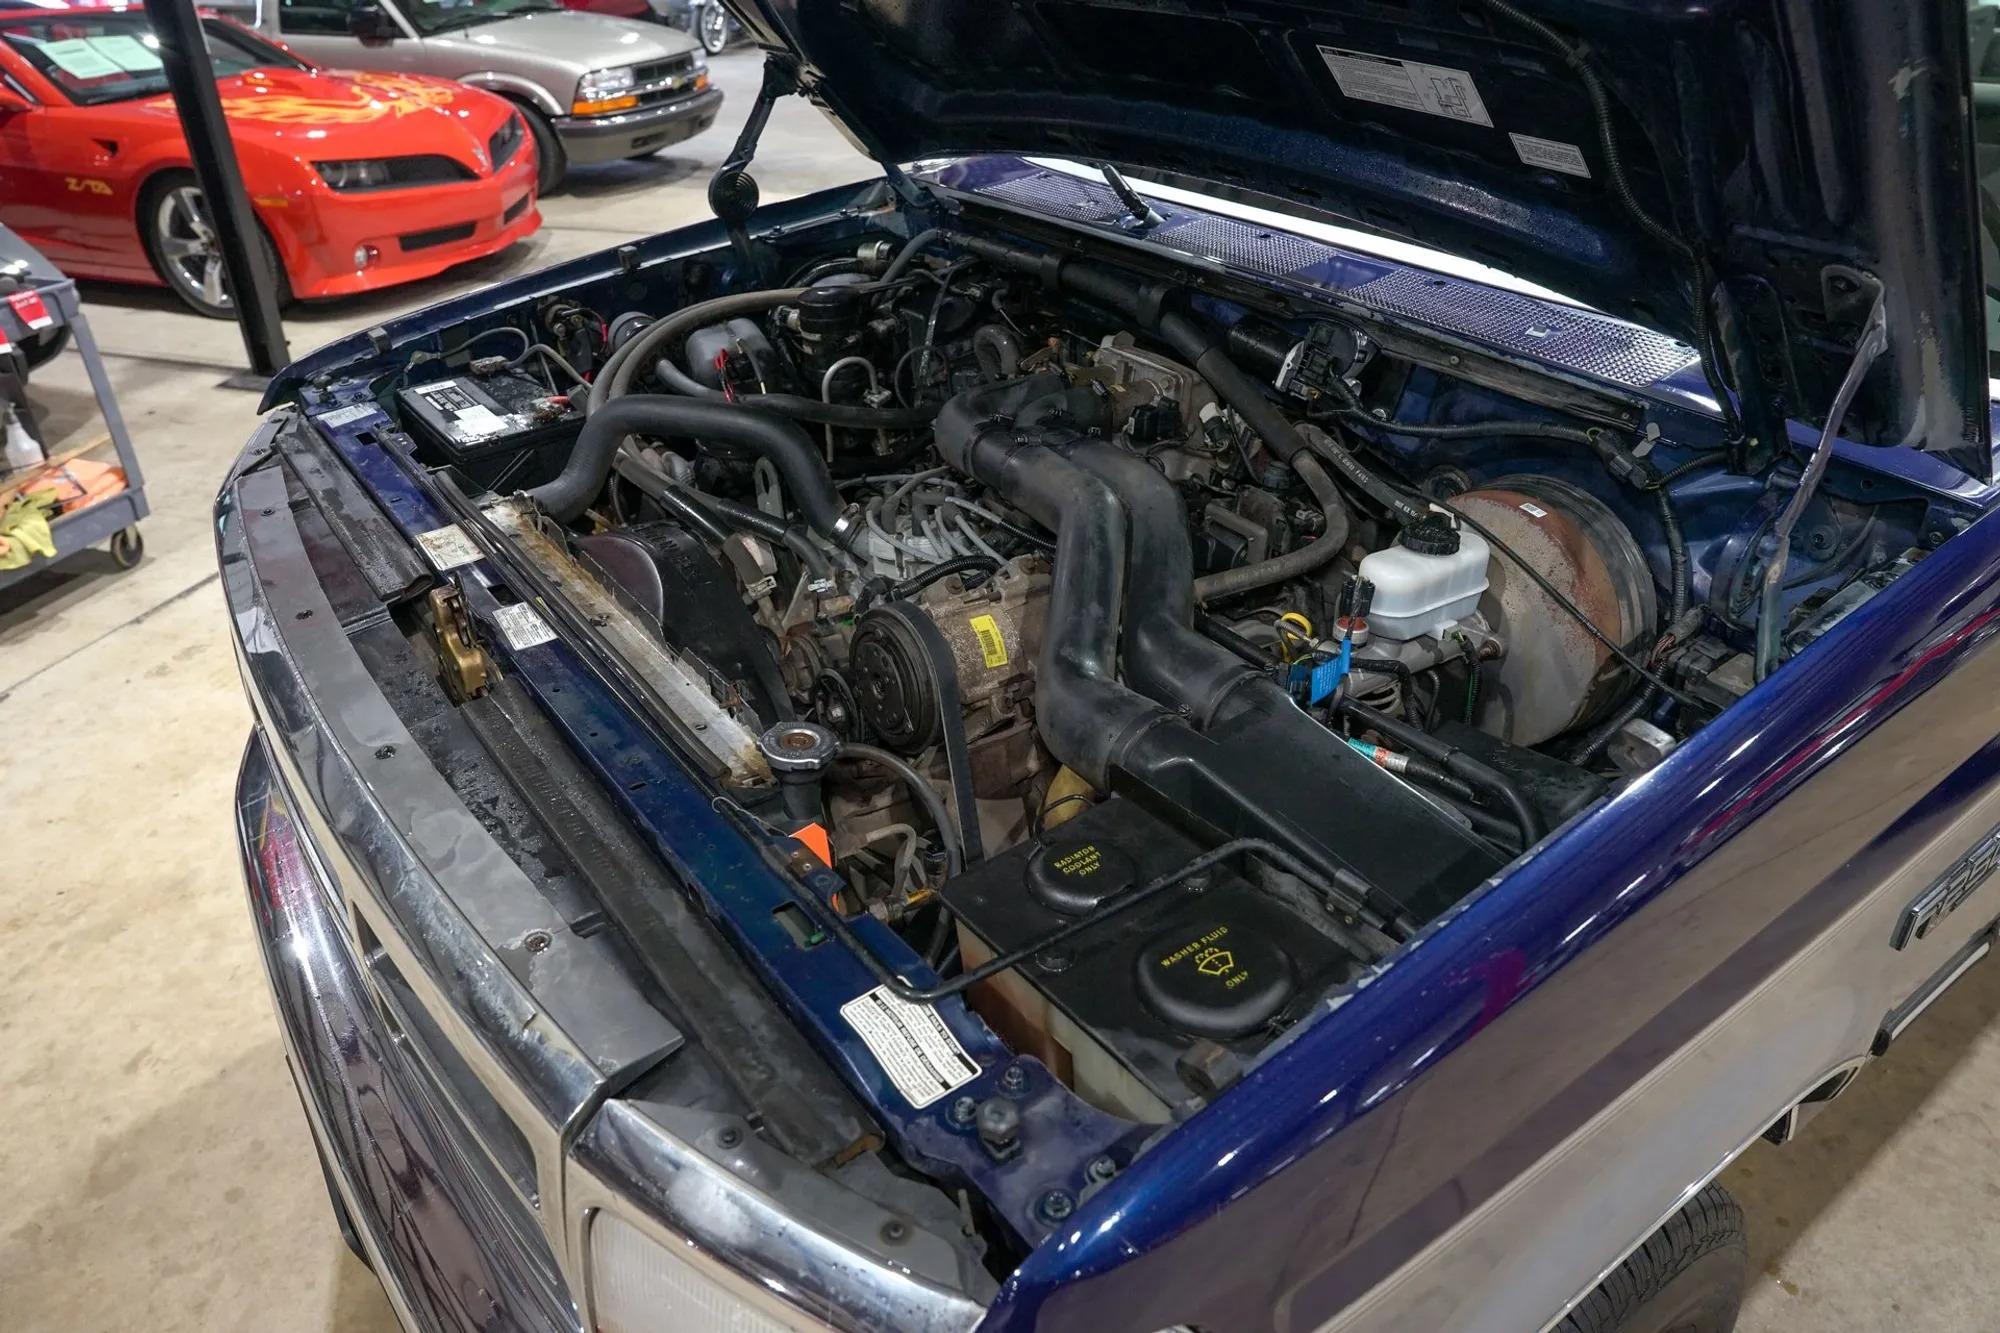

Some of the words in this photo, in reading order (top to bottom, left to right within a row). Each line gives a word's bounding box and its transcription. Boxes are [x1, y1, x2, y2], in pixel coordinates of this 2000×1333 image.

[1054, 845, 1095, 868] RADIATOR
[1063, 852, 1101, 874] COOLANT
[1079, 862, 1100, 875] ONLY
[1889, 832, 2000, 951] F25
[1161, 942, 1200, 967] WASHER
[1201, 927, 1228, 944] FLUID
[1225, 971, 1248, 987] ONLY
